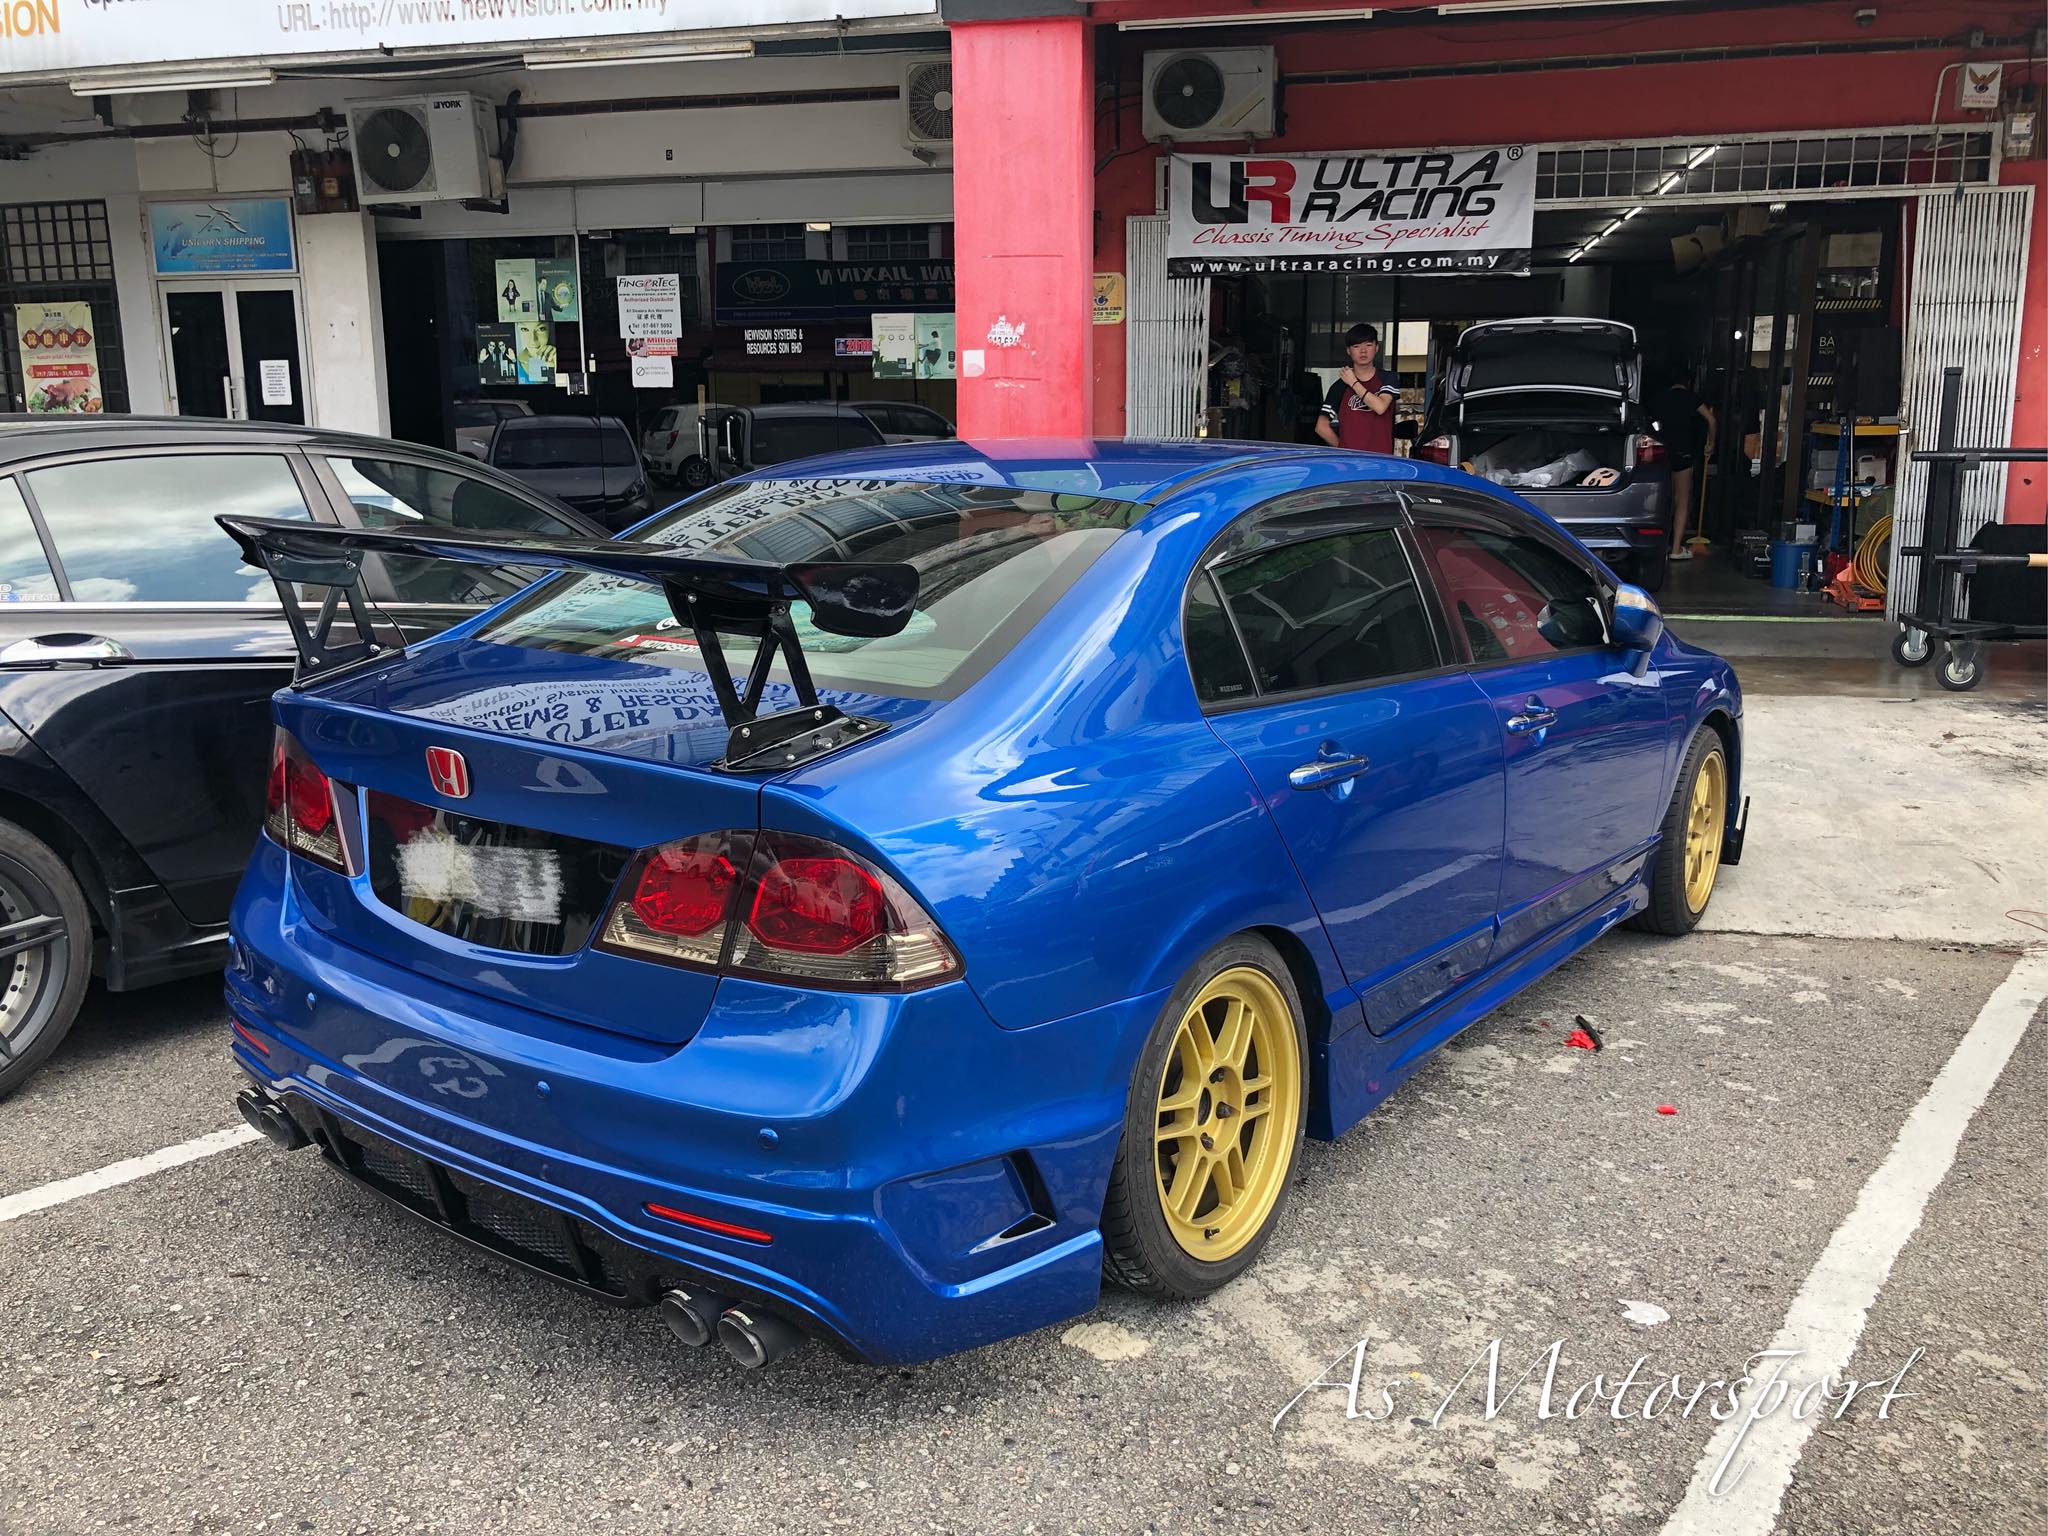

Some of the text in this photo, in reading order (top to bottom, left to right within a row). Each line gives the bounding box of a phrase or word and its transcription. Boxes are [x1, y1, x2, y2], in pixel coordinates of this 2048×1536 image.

[0, 0, 61, 38] ION
[439, 100, 462, 109] YORK
[1313, 150, 1501, 190] ULTRA
[1191, 160, 1297, 224] UR
[1299, 183, 1504, 223] RACING
[182, 236, 265, 247] UNICORN SHIPPING
[1192, 216, 1492, 250] Chassis Tuning Specialist
[1190, 253, 1499, 273] www.ultraracing.com.my
[744, 329, 773, 341] NEWVISION
[773, 328, 797, 340] SYSTEMS
[746, 342, 802, 354] RESOURCES SDN BHD
